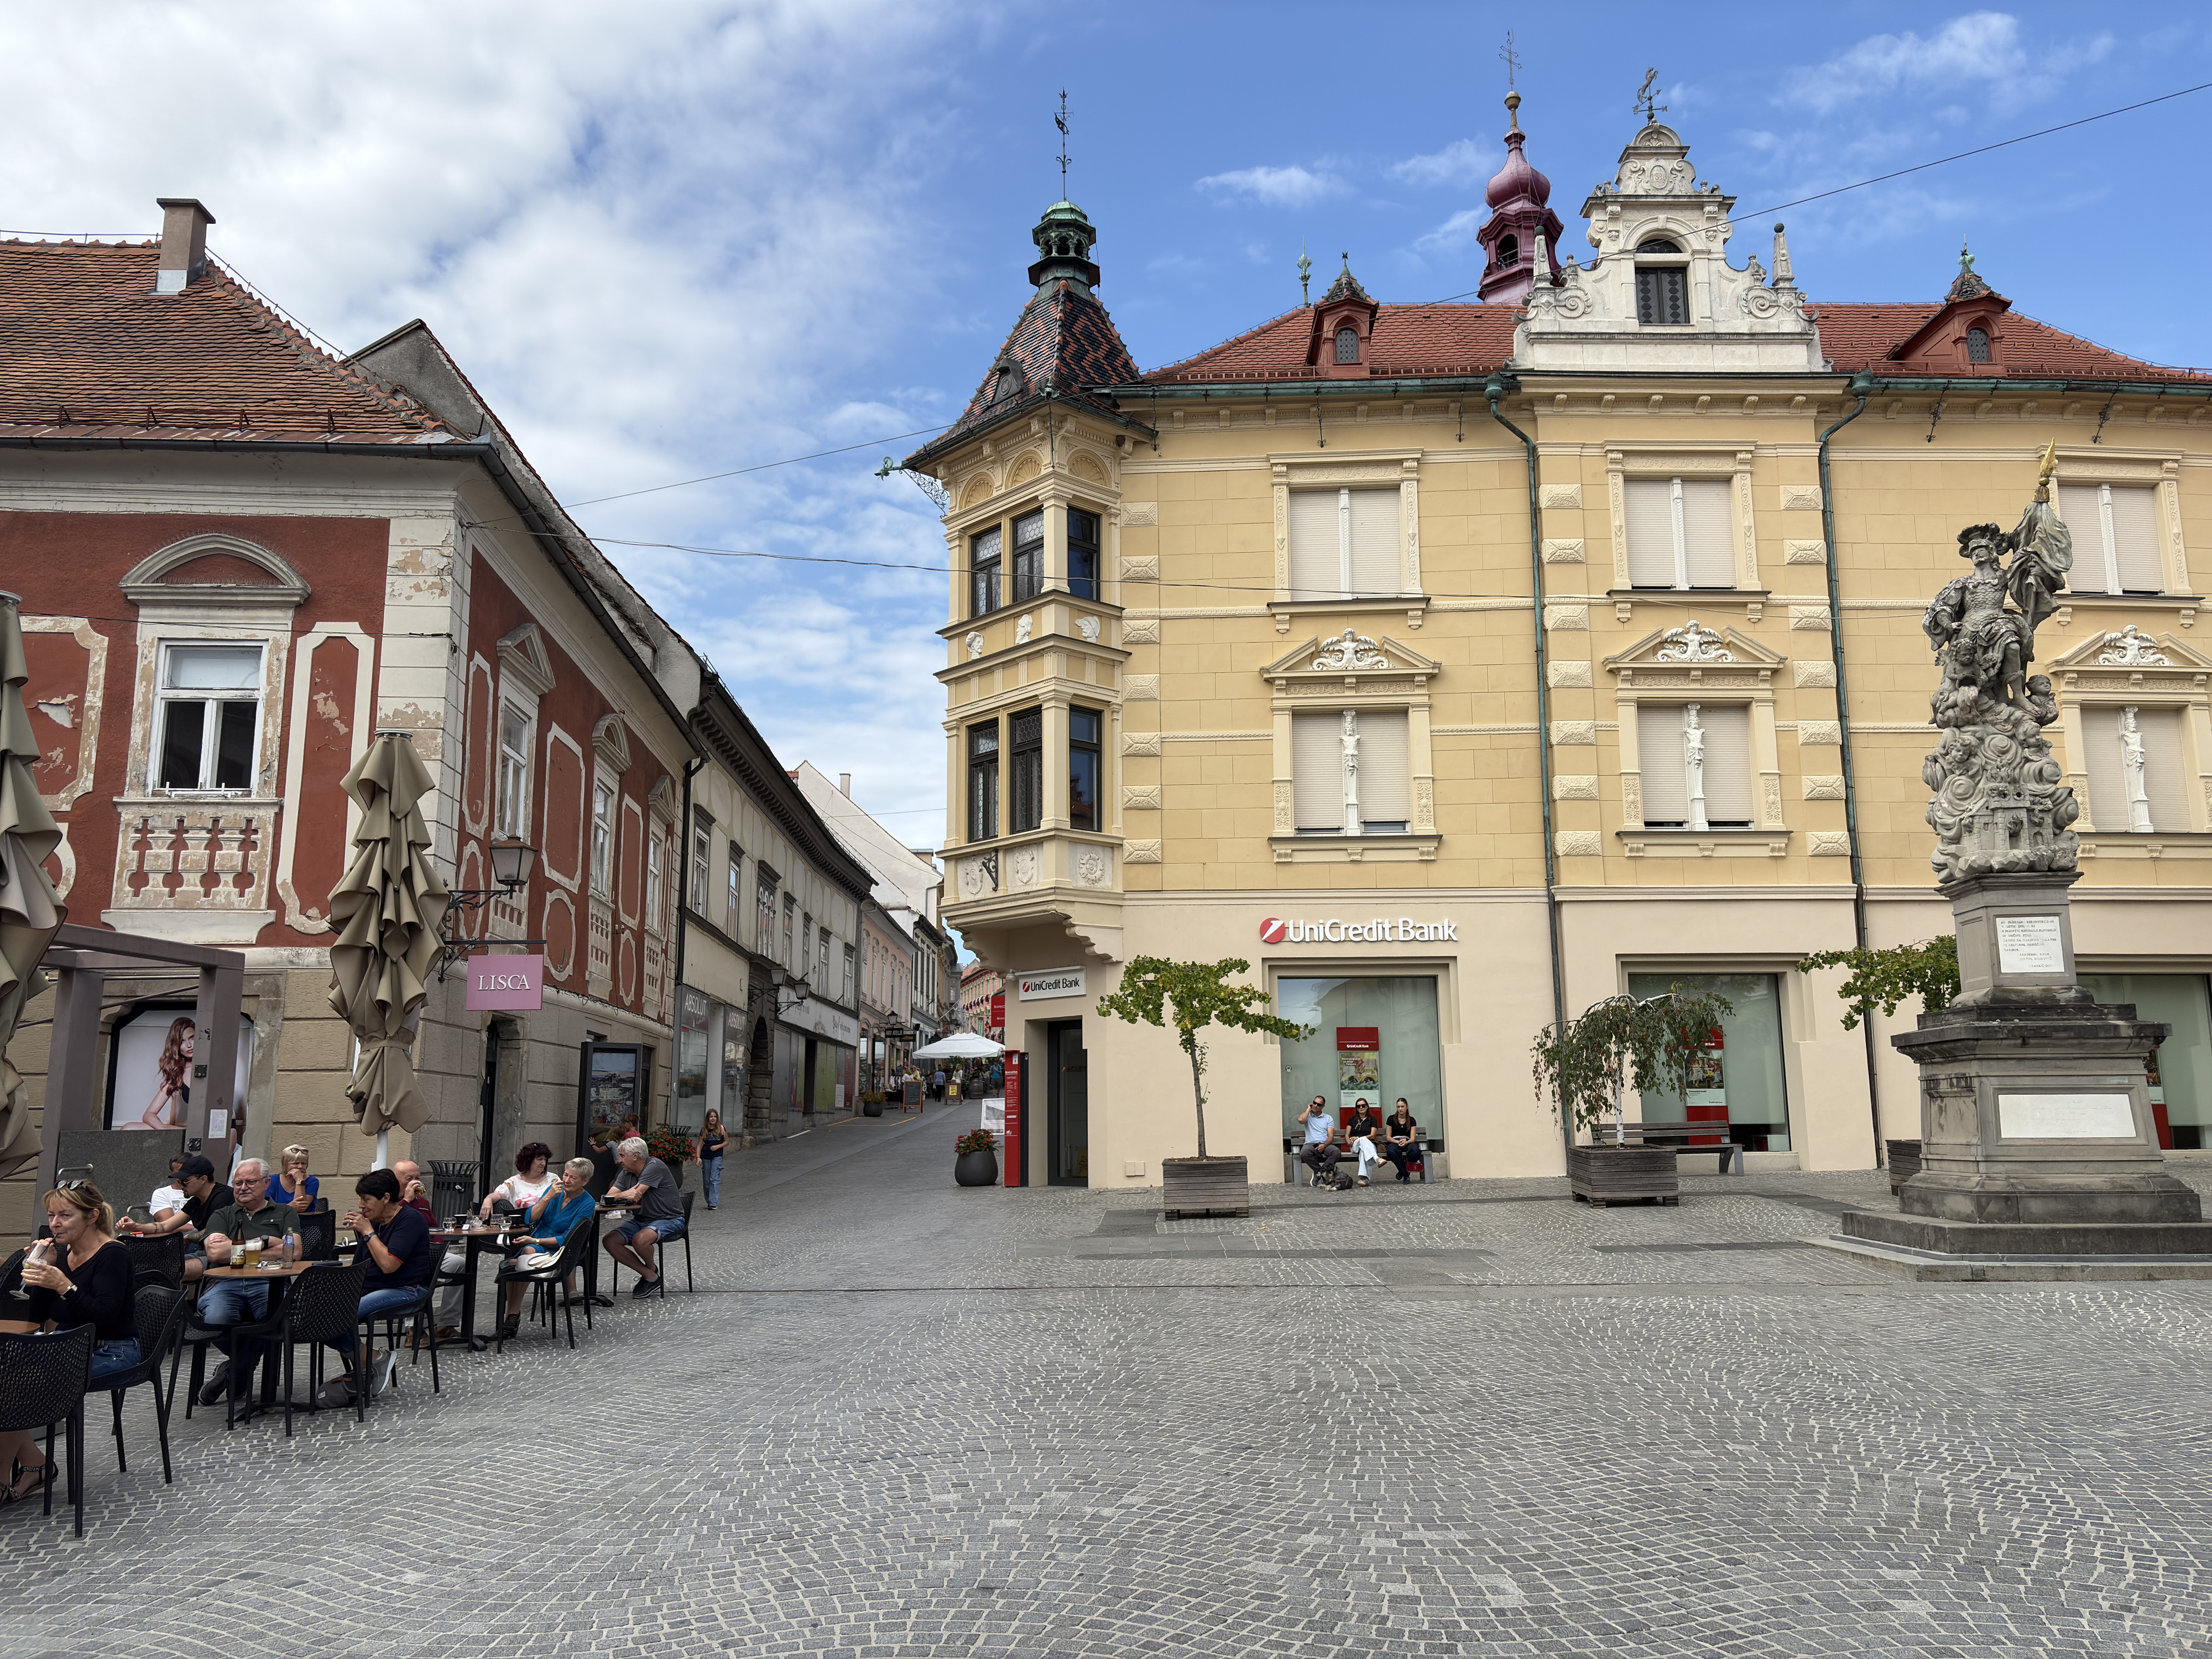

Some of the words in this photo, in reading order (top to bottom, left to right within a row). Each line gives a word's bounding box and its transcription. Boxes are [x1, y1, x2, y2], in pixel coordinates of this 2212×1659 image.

[1288, 919, 1393, 942] UniCredit
[1398, 918, 1458, 941] Bank
[477, 974, 531, 990] LISCA
[1031, 979, 1061, 992] UniCredit
[1062, 977, 1079, 988] Bank
[685, 993, 707, 1016] ABSOLUT
[728, 1012, 745, 1030] ABSOLUT
